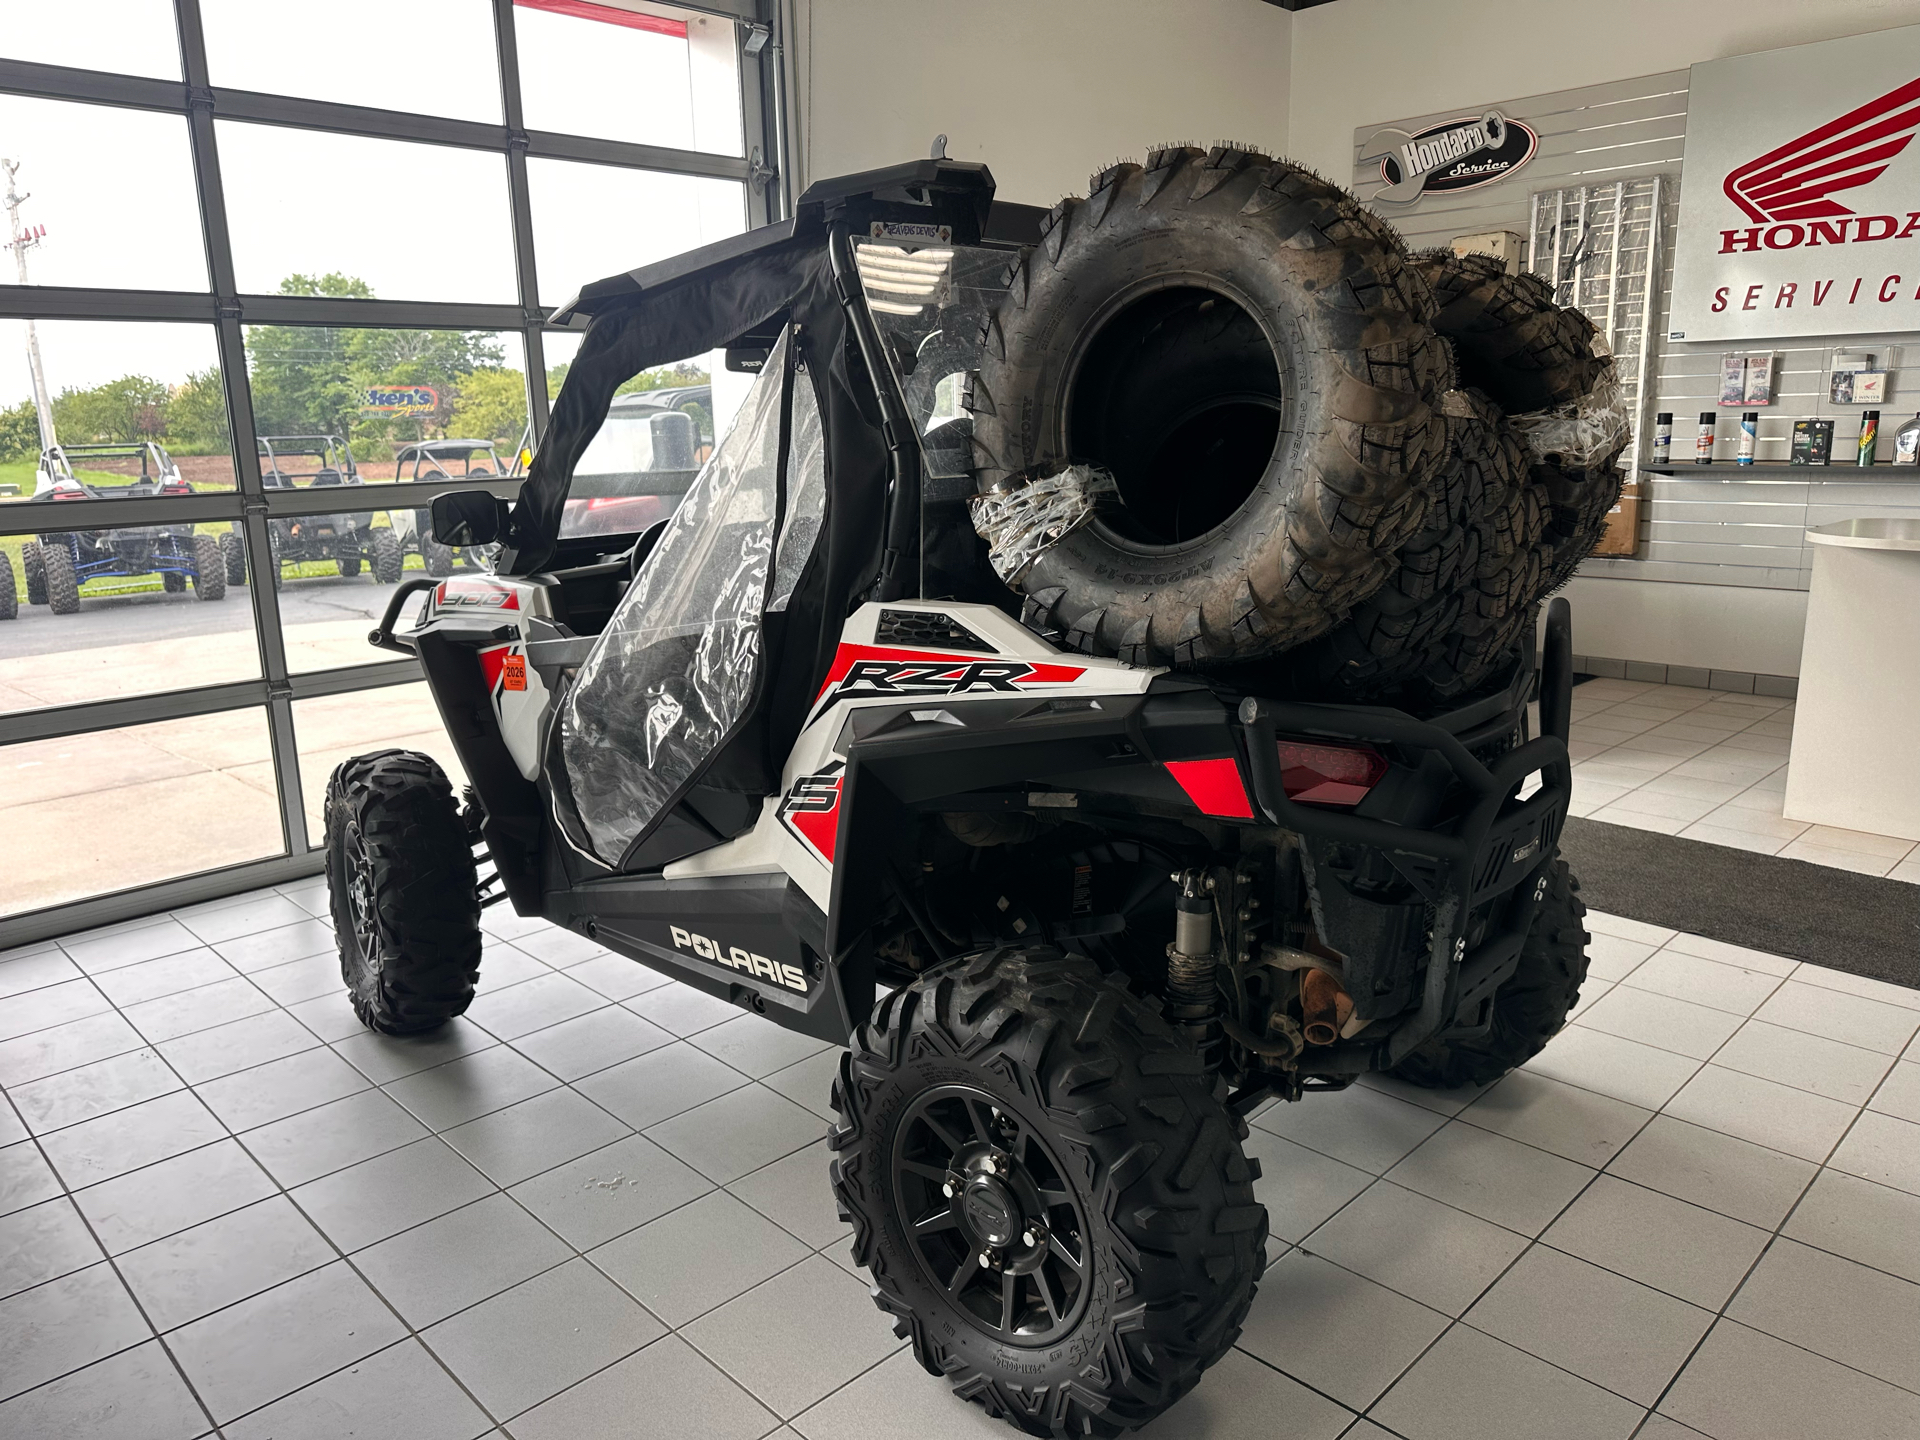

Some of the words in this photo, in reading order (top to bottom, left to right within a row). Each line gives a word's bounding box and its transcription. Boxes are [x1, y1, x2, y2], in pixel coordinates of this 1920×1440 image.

[1401, 125, 1485, 178] HondaPro
[1450, 159, 1510, 176] Service
[916, 226, 936, 238] DEVILS
[1711, 275, 1920, 313] SERVIC
[392, 401, 435, 418] Sports
[1021, 396, 1033, 467] ICTORY
[441, 591, 511, 607] 900
[506, 666, 525, 678] 2026
[835, 660, 1038, 696] RZR
[783, 775, 841, 813] S
[669, 925, 808, 992] POLARIS
